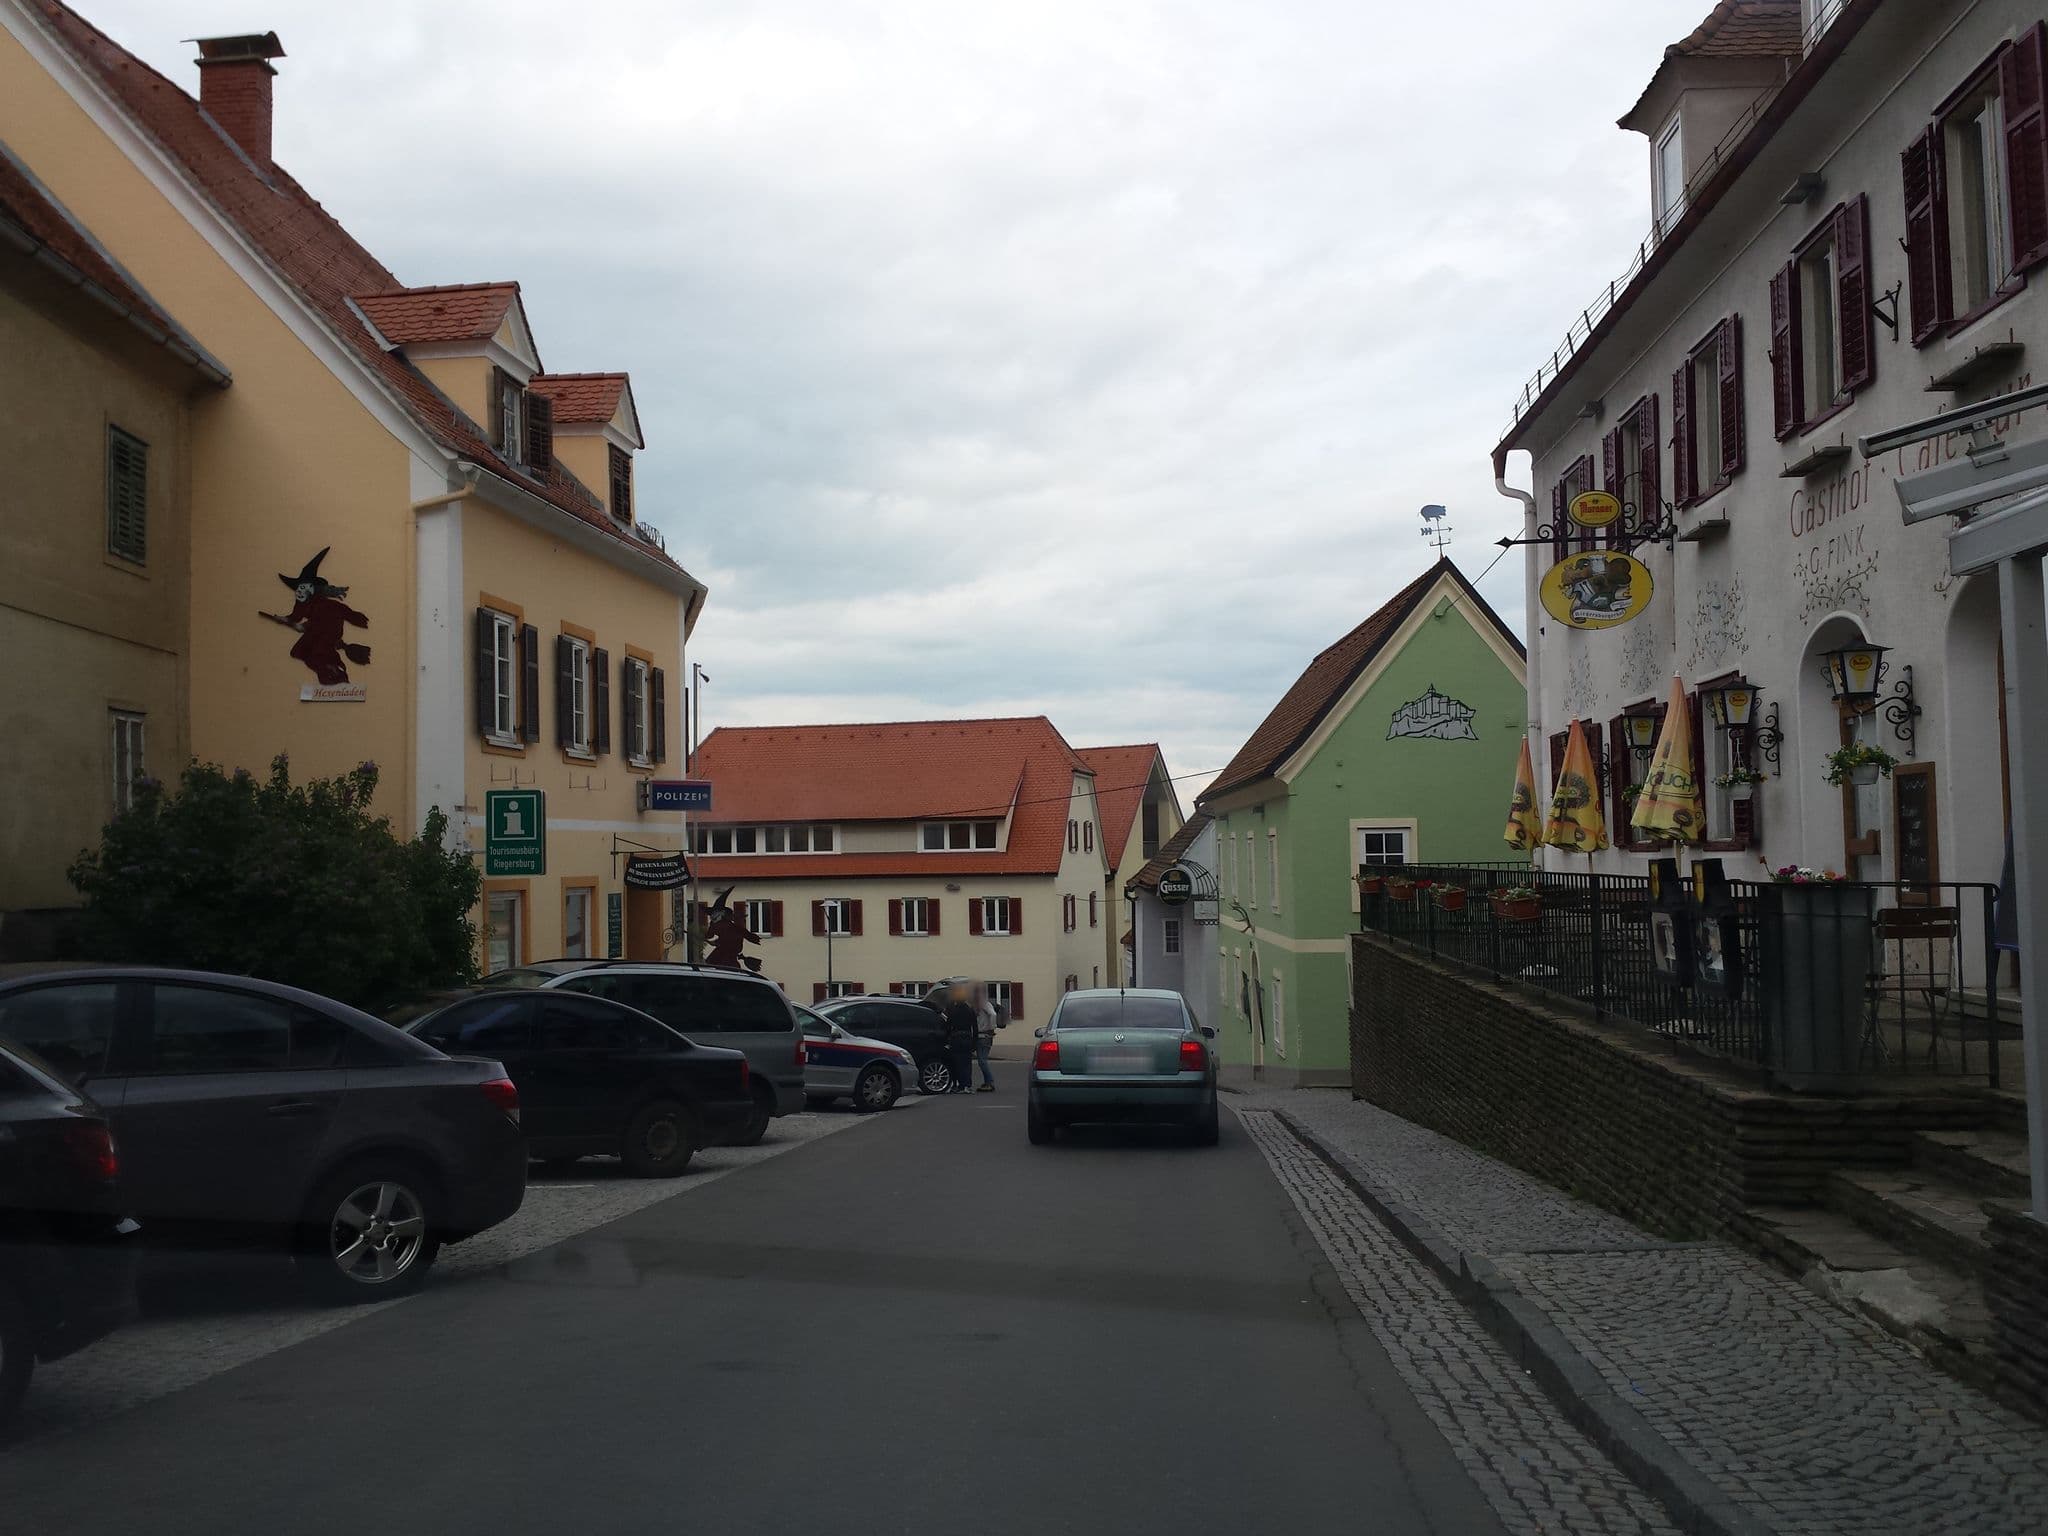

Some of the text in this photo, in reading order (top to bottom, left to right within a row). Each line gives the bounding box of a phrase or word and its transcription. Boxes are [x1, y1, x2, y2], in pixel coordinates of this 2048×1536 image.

[1827, 524, 1865, 569] FINK
[313, 686, 366, 699] Hexenladen
[656, 792, 702, 801] POLIZEI
[489, 846, 540, 857] Tourismusbüro
[493, 858, 535, 870] Riegersburg
